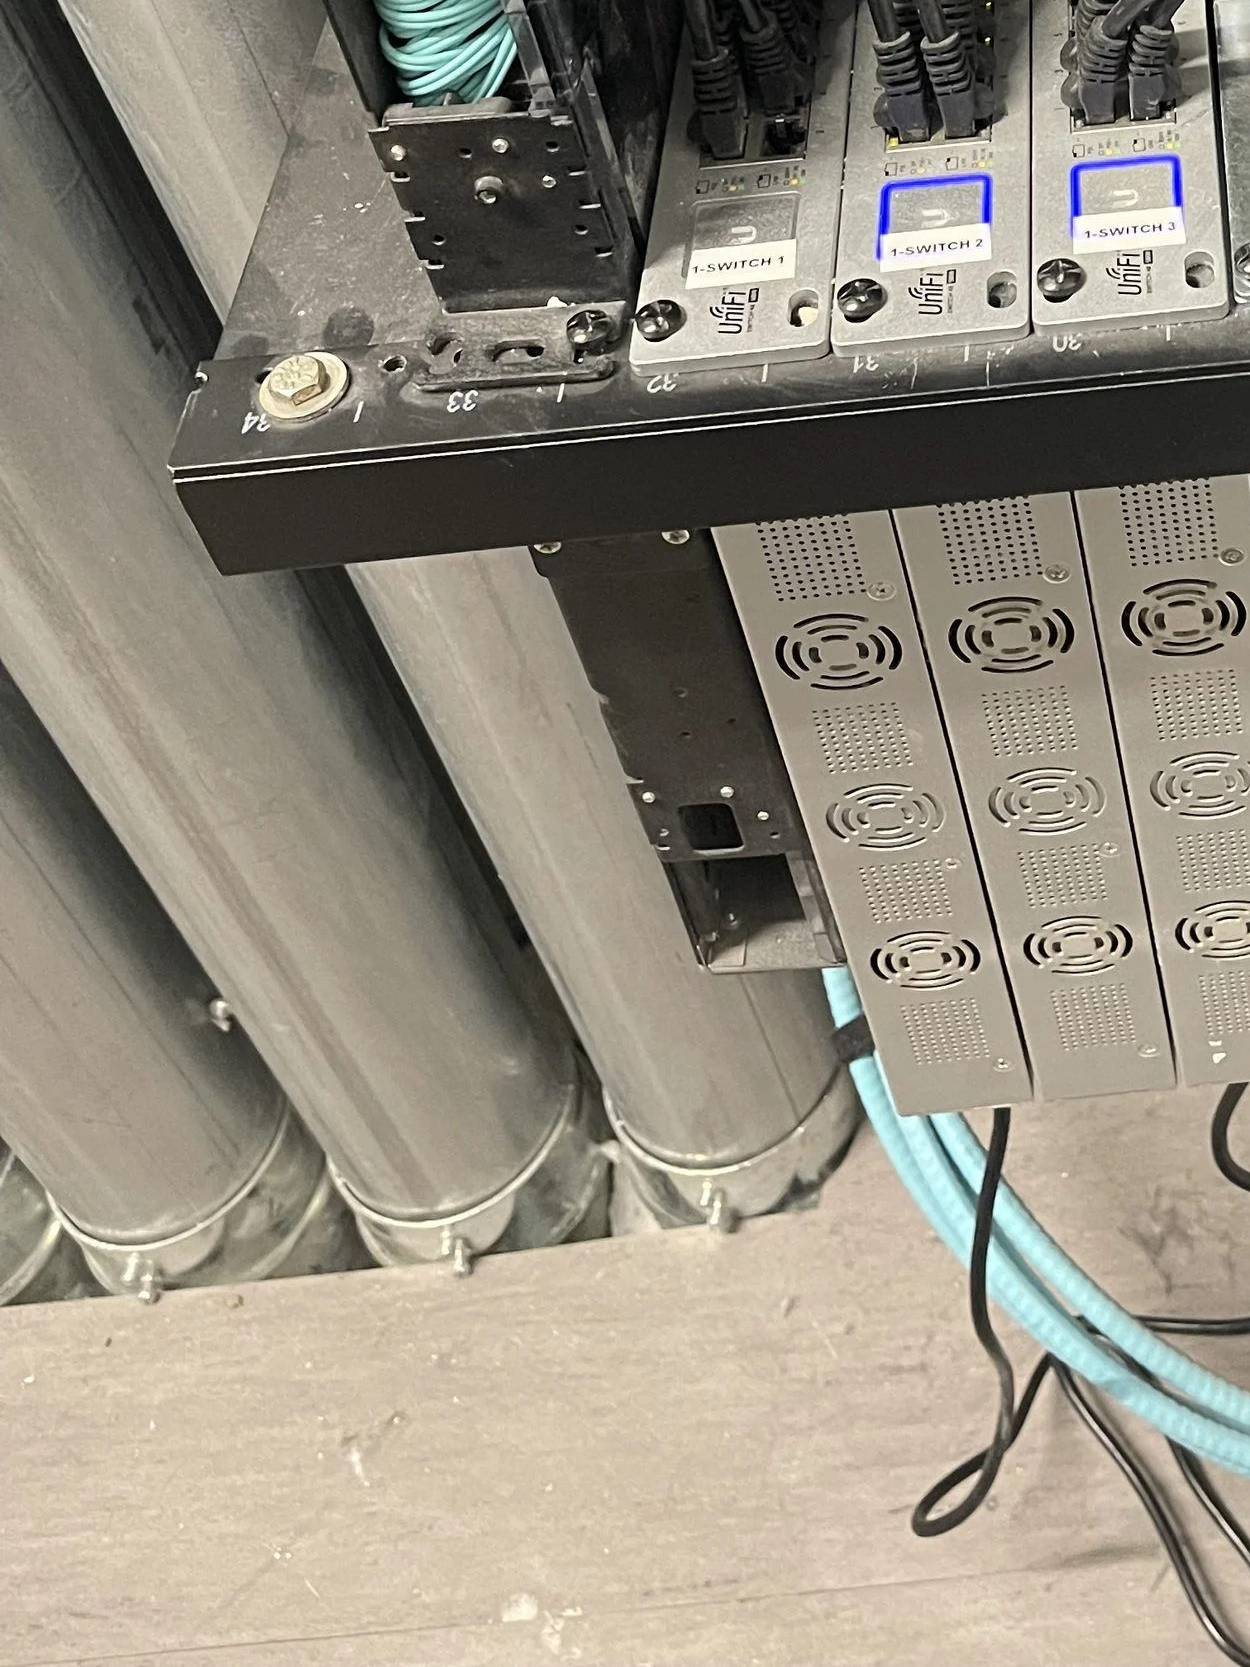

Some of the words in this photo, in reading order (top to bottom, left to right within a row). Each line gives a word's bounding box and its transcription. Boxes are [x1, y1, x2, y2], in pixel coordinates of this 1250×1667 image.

[1084, 222, 1163, 239] 1-SWITCH
[1167, 221, 1176, 231] 3
[890, 238, 971, 257] 1-SWITCH
[974, 238, 984, 248] 2
[691, 257, 773, 274] 1-SWITCH
[777, 255, 785, 265] 1
[445, 389, 480, 414] 33
